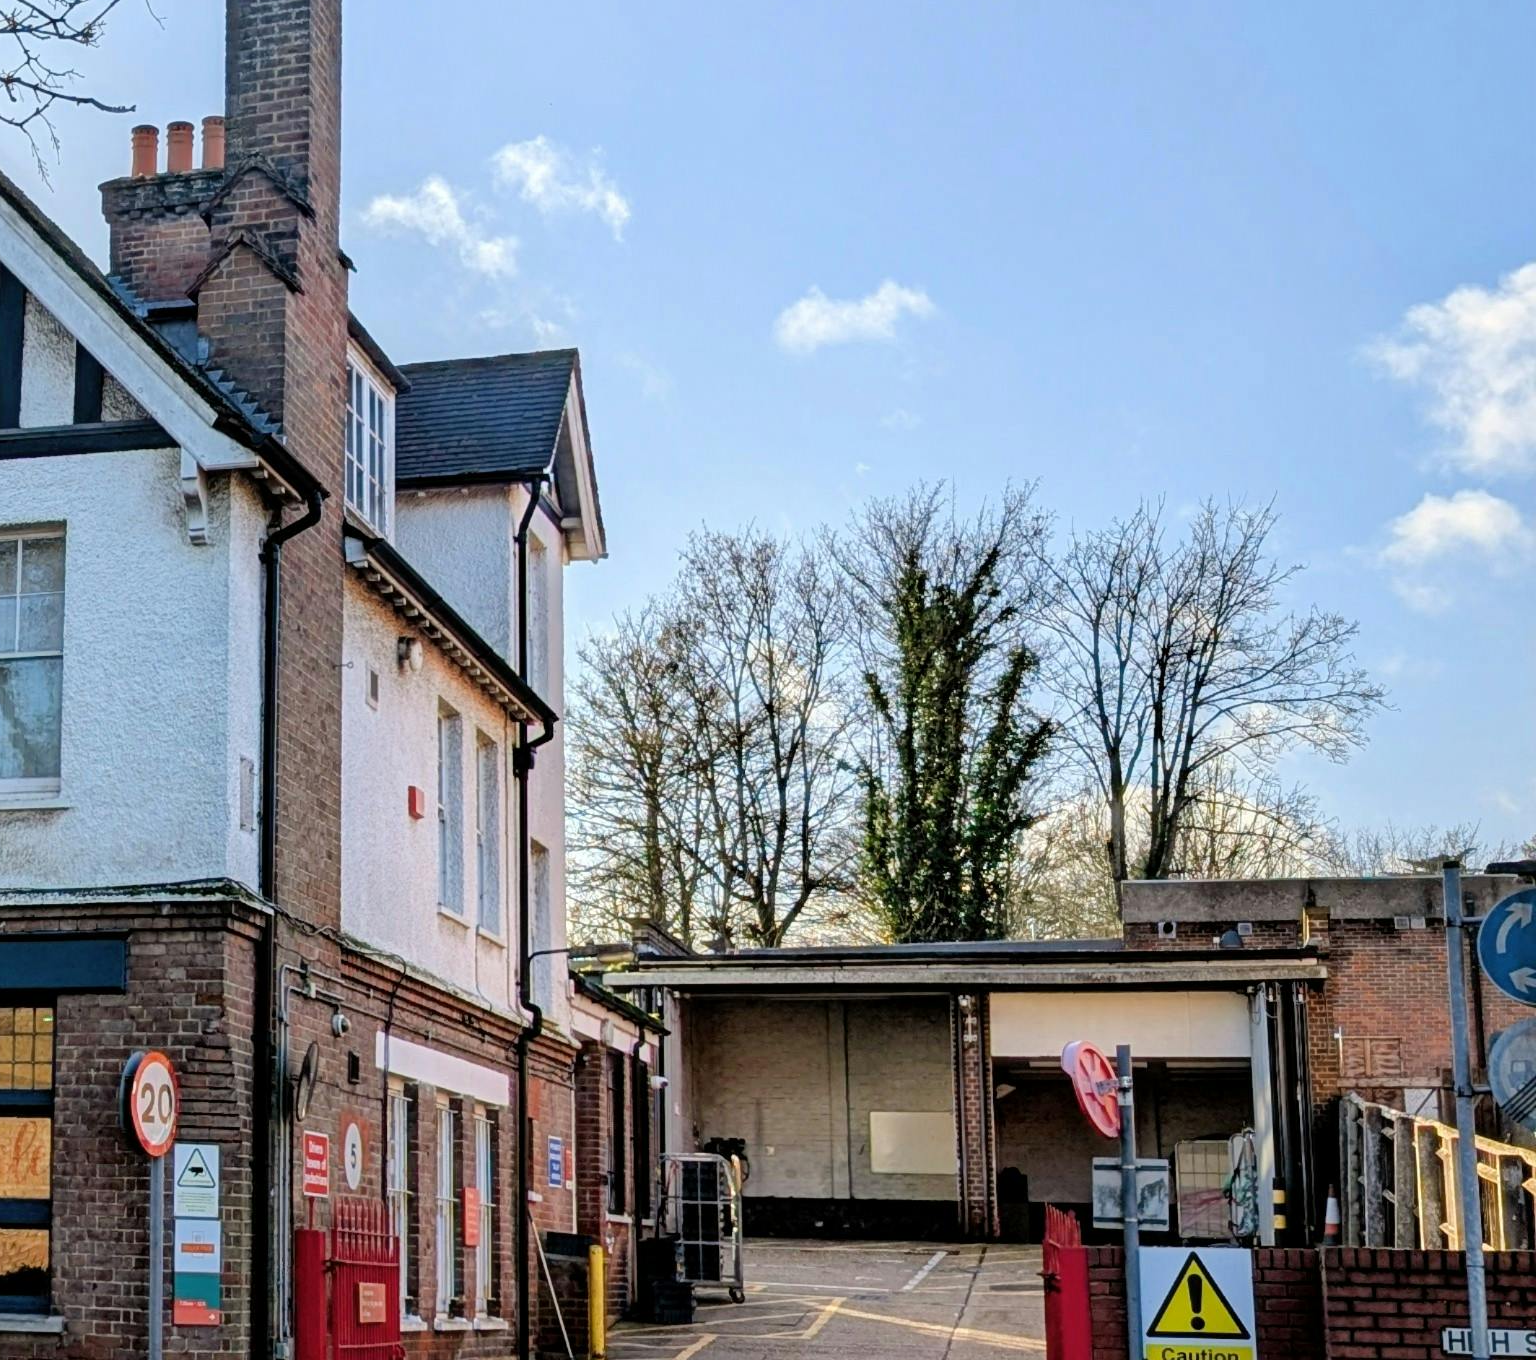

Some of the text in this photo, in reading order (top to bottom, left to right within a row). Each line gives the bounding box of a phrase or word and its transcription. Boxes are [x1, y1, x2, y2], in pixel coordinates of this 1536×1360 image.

[141, 1082, 173, 1125] 20
[350, 1143, 357, 1169] 5
[1448, 1330, 1510, 1353] HIH
